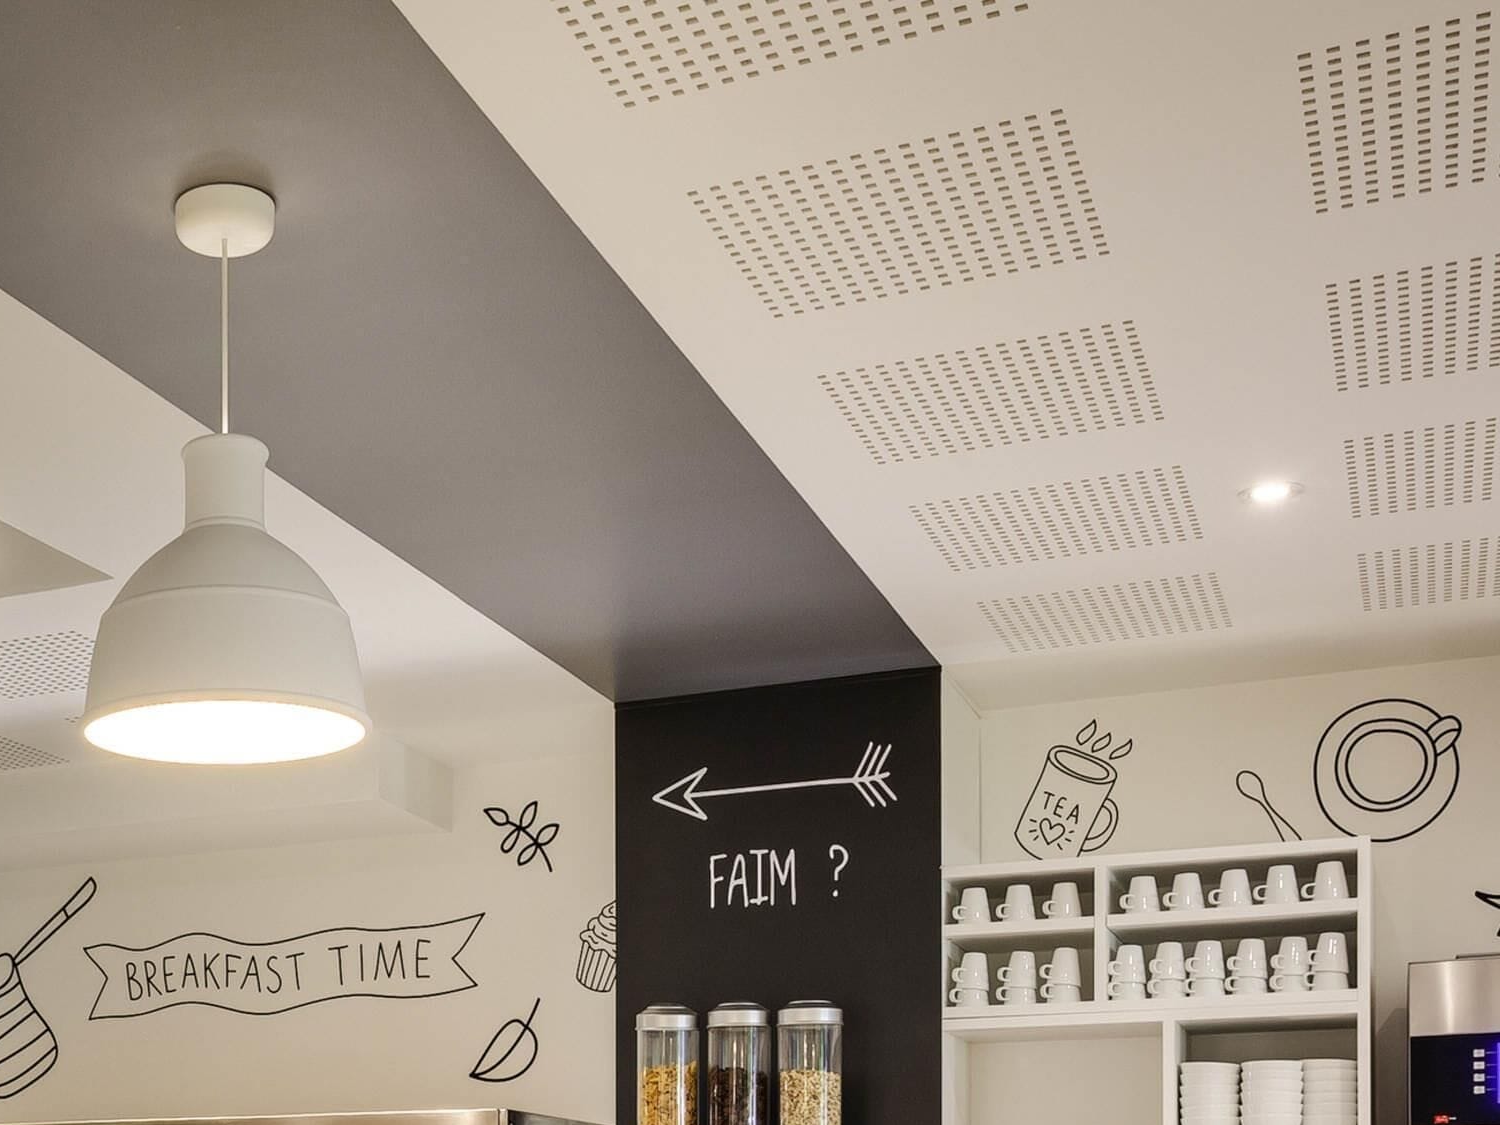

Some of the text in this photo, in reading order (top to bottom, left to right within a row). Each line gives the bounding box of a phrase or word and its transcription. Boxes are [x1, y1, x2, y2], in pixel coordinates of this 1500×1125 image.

[1043, 790, 1079, 825] TEA
[709, 844, 850, 909] FAIM ?
[125, 938, 432, 1001] BREAKFAST TIME
